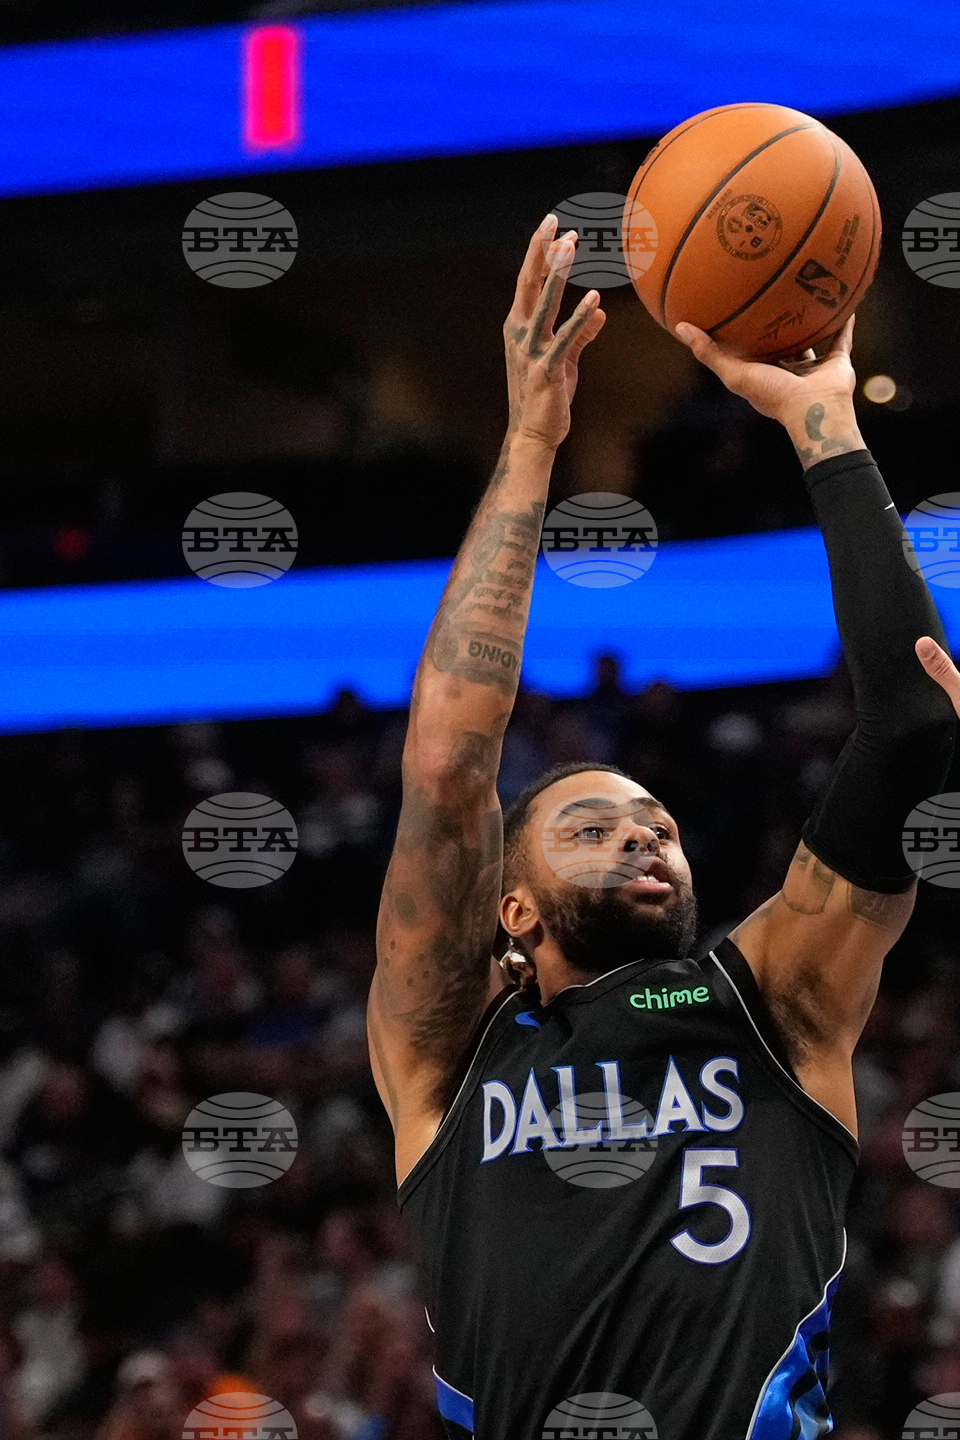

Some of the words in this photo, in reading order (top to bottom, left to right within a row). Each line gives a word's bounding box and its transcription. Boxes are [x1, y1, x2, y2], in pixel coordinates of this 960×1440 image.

[629, 985, 710, 1010] chime
[479, 1053, 745, 1165] DALLAS
[669, 1146, 752, 1265] 5
